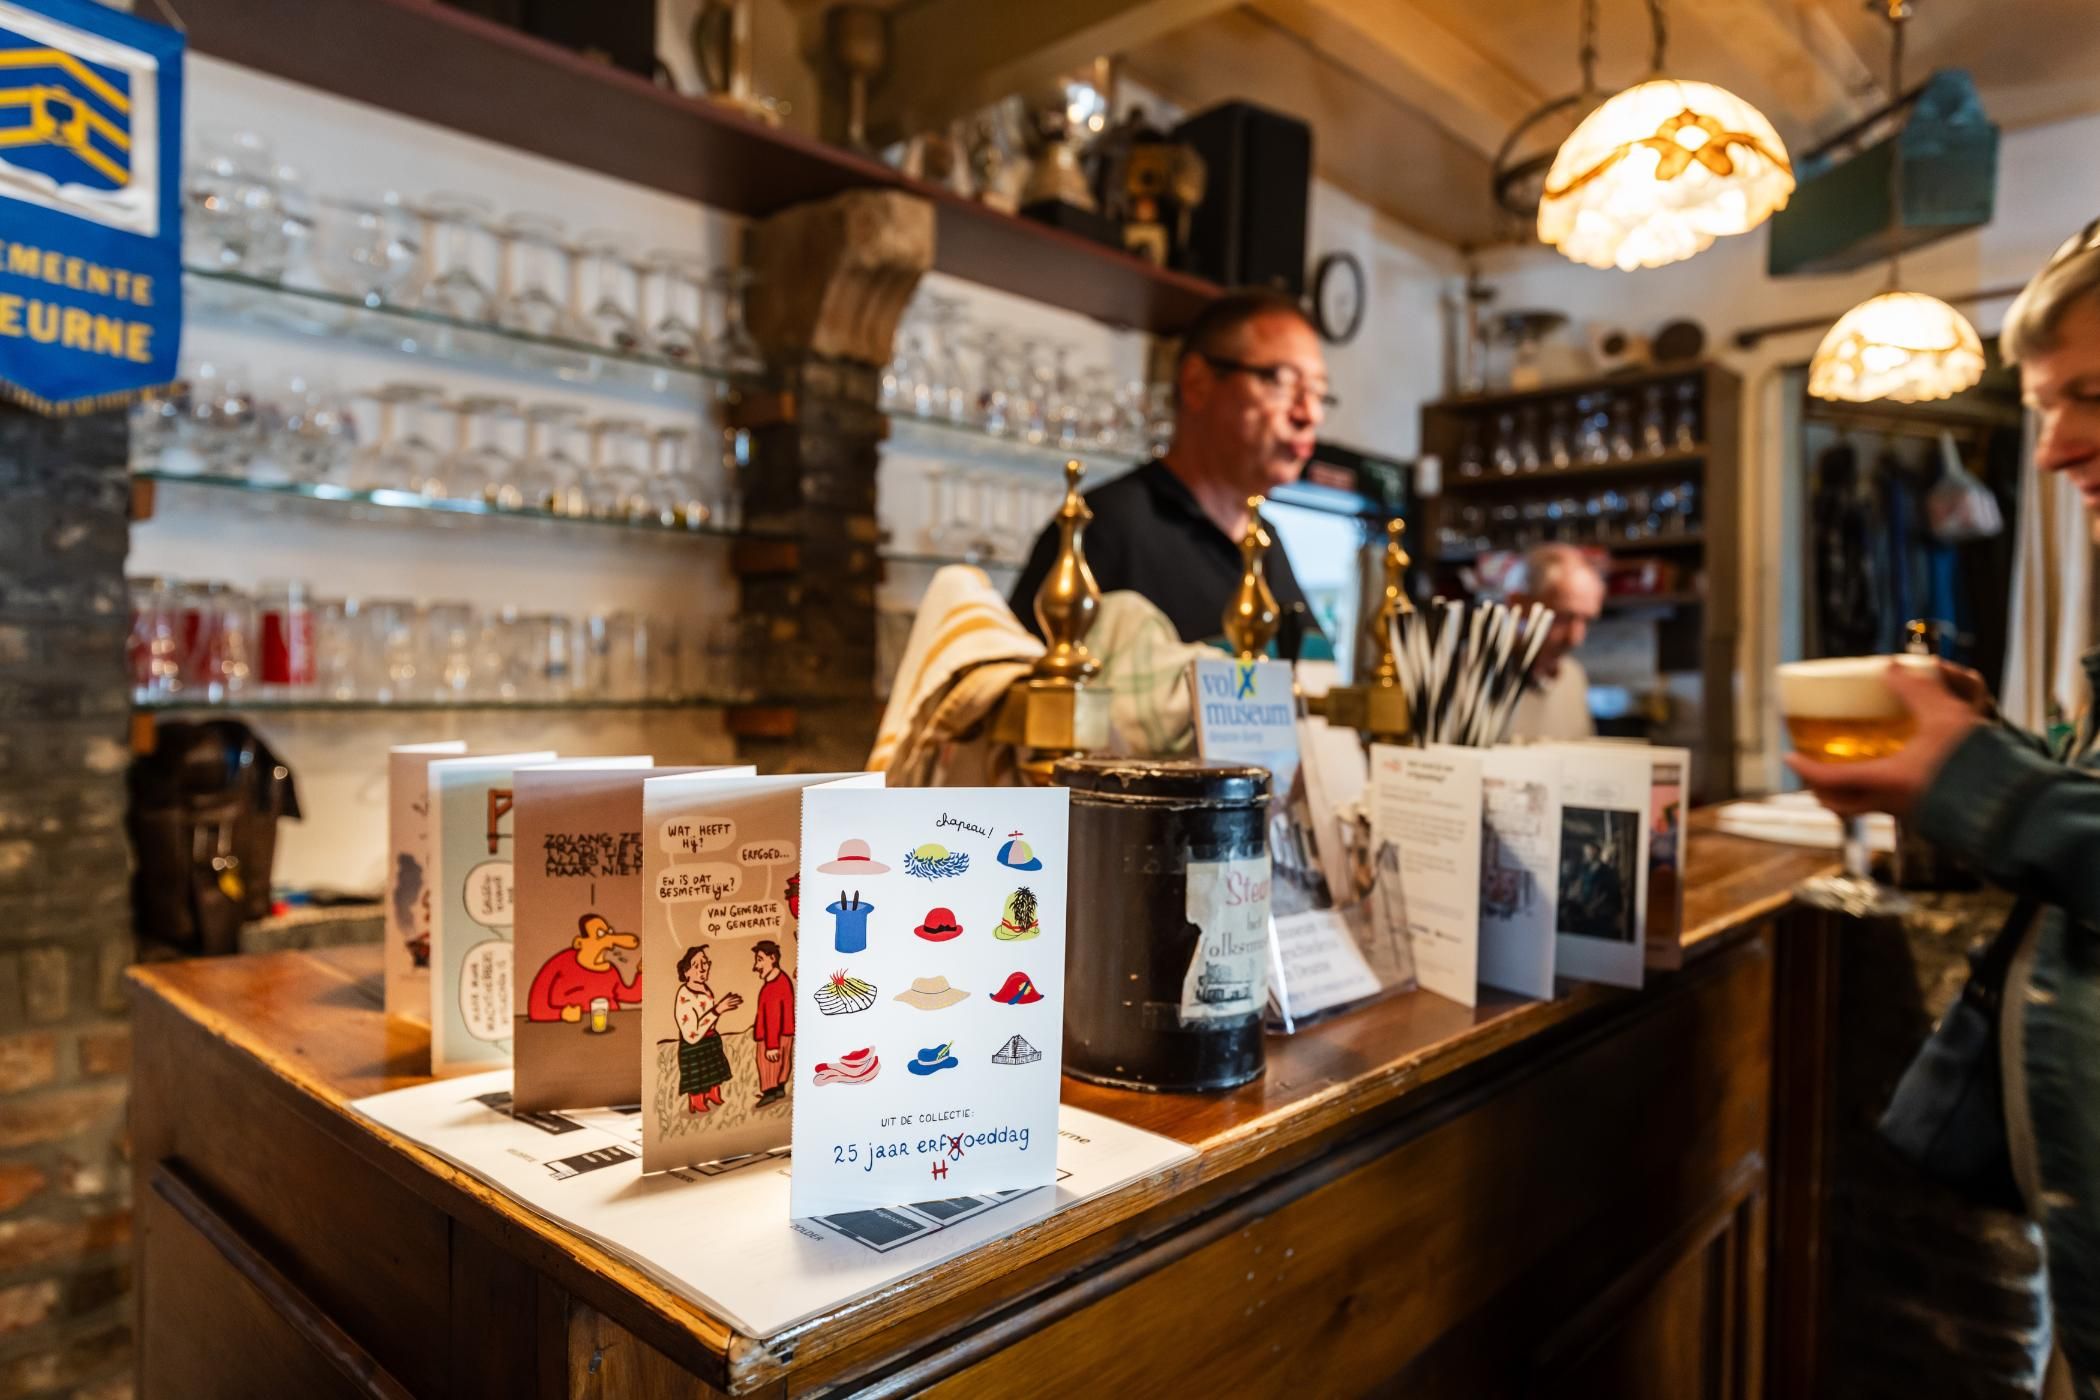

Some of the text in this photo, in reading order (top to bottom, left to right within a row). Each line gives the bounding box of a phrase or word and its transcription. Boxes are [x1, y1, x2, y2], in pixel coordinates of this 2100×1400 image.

[0, 238, 155, 306] MEENTE
[1205, 703, 1291, 726] museum
[668, 823, 731, 837] WAT HEEFT
[936, 812, 994, 839] chapeau!
[544, 833, 613, 846] ZOLANG
[546, 854, 599, 867] ALLES
[546, 865, 597, 878] MAAR
[693, 874, 712, 885] DAT
[707, 906, 727, 918] VAN
[881, 1109, 975, 1128] UIT DE COLLECTIE:
[833, 1143, 859, 1165] 25
[931, 1159, 949, 1181] H
[789, 1223, 825, 1241] ZOLDER
